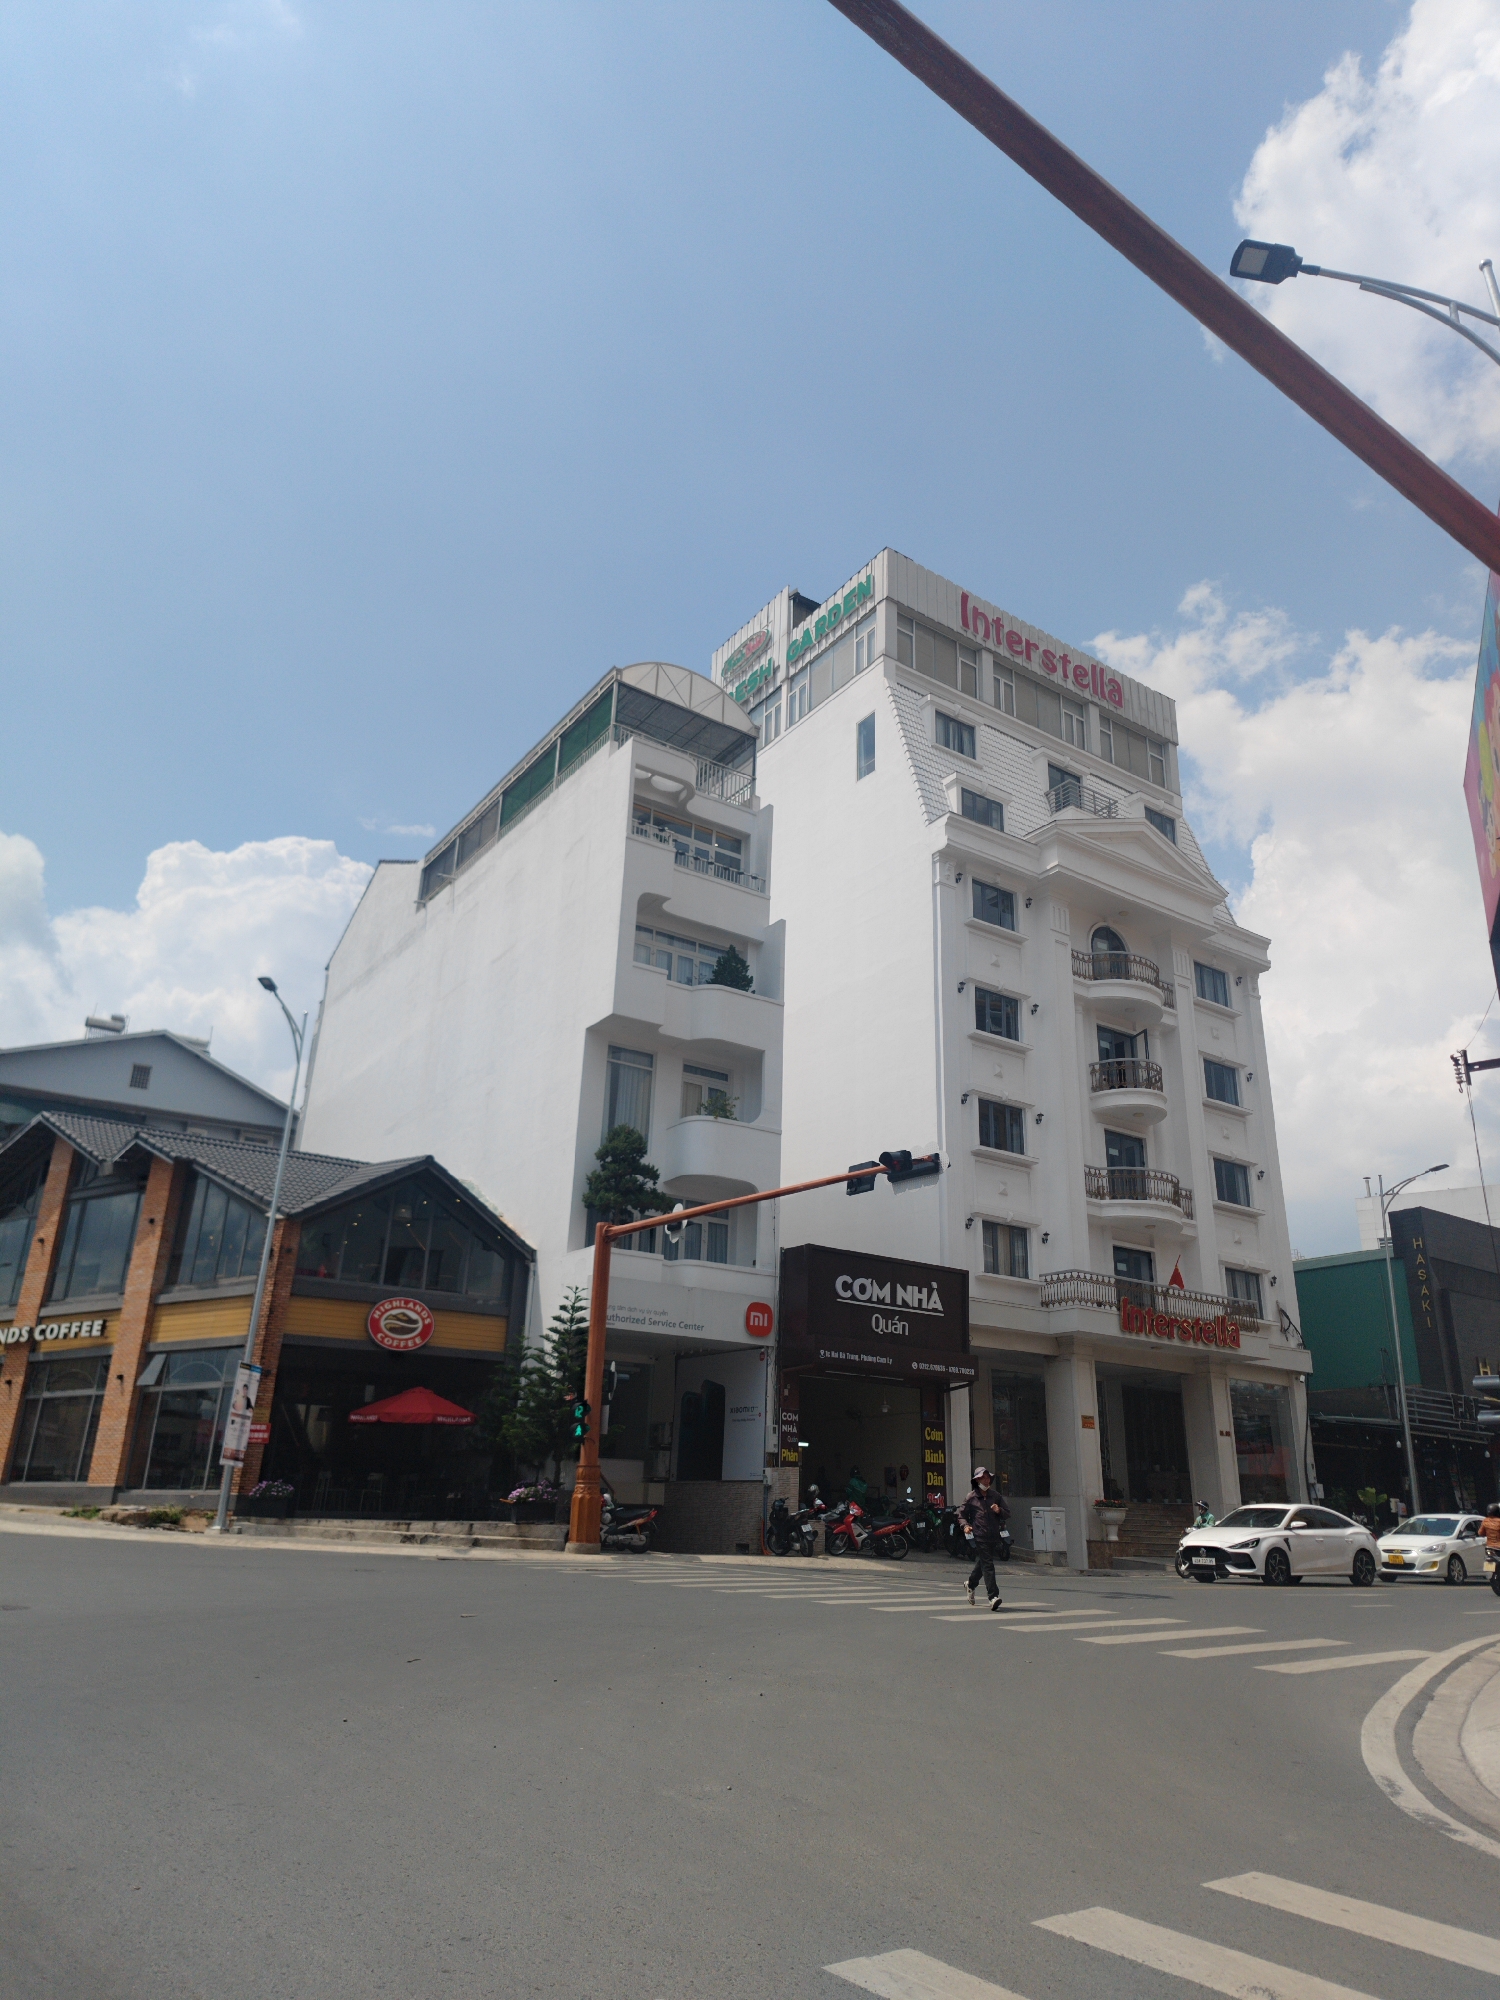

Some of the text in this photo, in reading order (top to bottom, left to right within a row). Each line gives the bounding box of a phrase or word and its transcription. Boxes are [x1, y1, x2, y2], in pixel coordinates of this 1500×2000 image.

[786, 574, 873, 663] GARDEN
[961, 591, 1123, 708] Interstella
[835, 1274, 944, 1311] CƠM NHÀ
[1412, 1237, 1432, 1328] HASAKI
[373, 1299, 432, 1325] HIGHLANDS
[606, 1313, 705, 1332] uthorized Service Center
[1120, 1296, 1240, 1348] Interstella
[33, 1319, 104, 1341] COFFEE
[871, 1313, 909, 1336] Quán
[376, 1332, 423, 1348] COFFEE
[782, 1423, 798, 1433] NHÀ
[924, 1426, 944, 1441] Cơm
[926, 1471, 944, 1486] Dân
